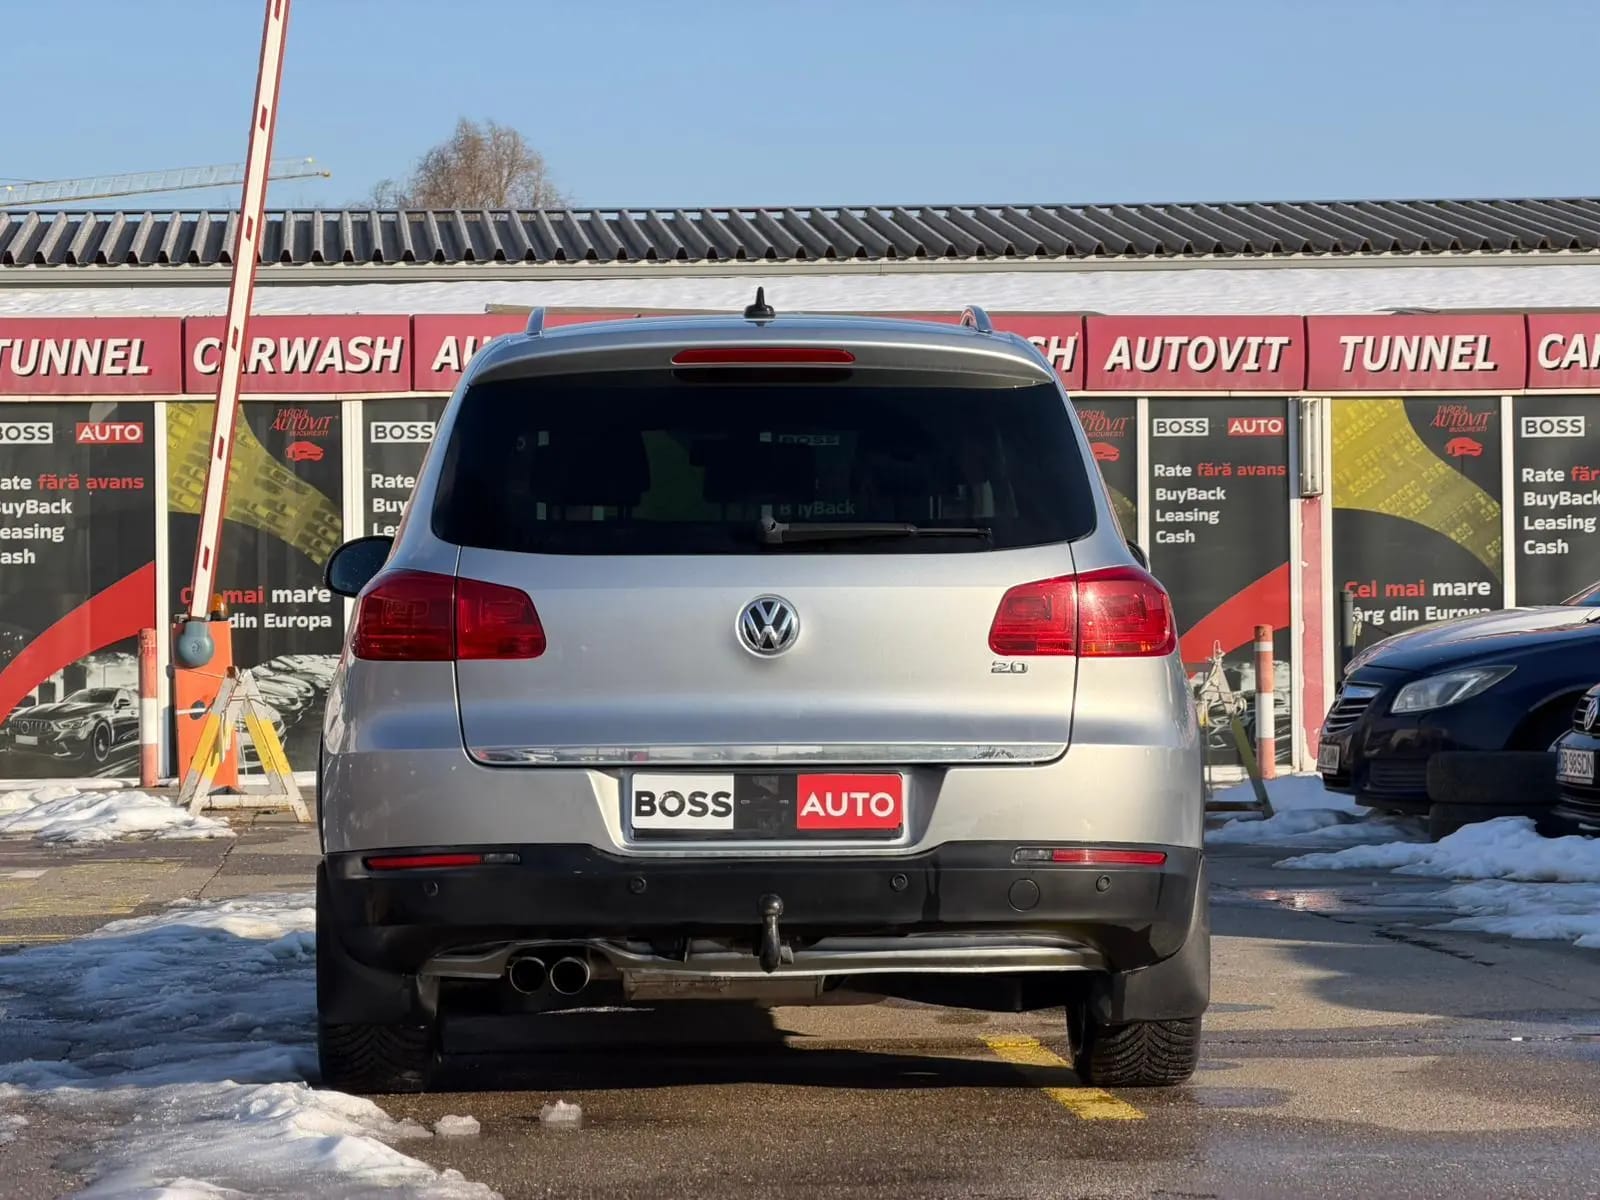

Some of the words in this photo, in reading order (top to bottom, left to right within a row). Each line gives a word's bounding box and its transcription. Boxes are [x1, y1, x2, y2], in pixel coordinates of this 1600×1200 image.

[193, 335, 403, 374] CRWASH
[1103, 336, 1291, 372] AUTOVIT
[1339, 335, 1498, 372] TUNNEL
[269, 416, 333, 431] AUTOVIT
[1156, 420, 1206, 434] BOSS
[1230, 419, 1282, 434] AUTO
[1525, 419, 1582, 434] BOSS
[0, 425, 50, 441] OSS
[79, 424, 142, 441] AUTO
[374, 424, 433, 440] BOSS
[1154, 464, 1192, 477] Rate
[1237, 465, 1286, 476] avans
[1522, 467, 1565, 482] Rate
[1571, 466, 1600, 481] făr
[0, 475, 32, 490] ate
[38, 474, 80, 490] fără
[86, 477, 144, 490] avans
[371, 473, 415, 489] Rate
[1156, 486, 1226, 503] BuyBack
[1523, 489, 1600, 509] BuyBack
[0, 498, 73, 518] uyBack
[1156, 508, 1220, 524] Leasing
[1523, 514, 1597, 533] Leasing
[0, 523, 65, 542] easing
[1156, 530, 1195, 543] Cash
[1524, 539, 1569, 554] Cash
[0, 548, 36, 564] ash
[222, 585, 265, 604] mai
[271, 586, 332, 603] mare
[1386, 579, 1425, 597] mai
[1433, 581, 1491, 596] mare
[1390, 606, 1416, 621] din
[1425, 606, 1491, 621] Euro
[228, 613, 257, 628] din
[264, 613, 332, 631] Europa
[635, 790, 732, 818] BOSS
[800, 792, 895, 817] AUTO
